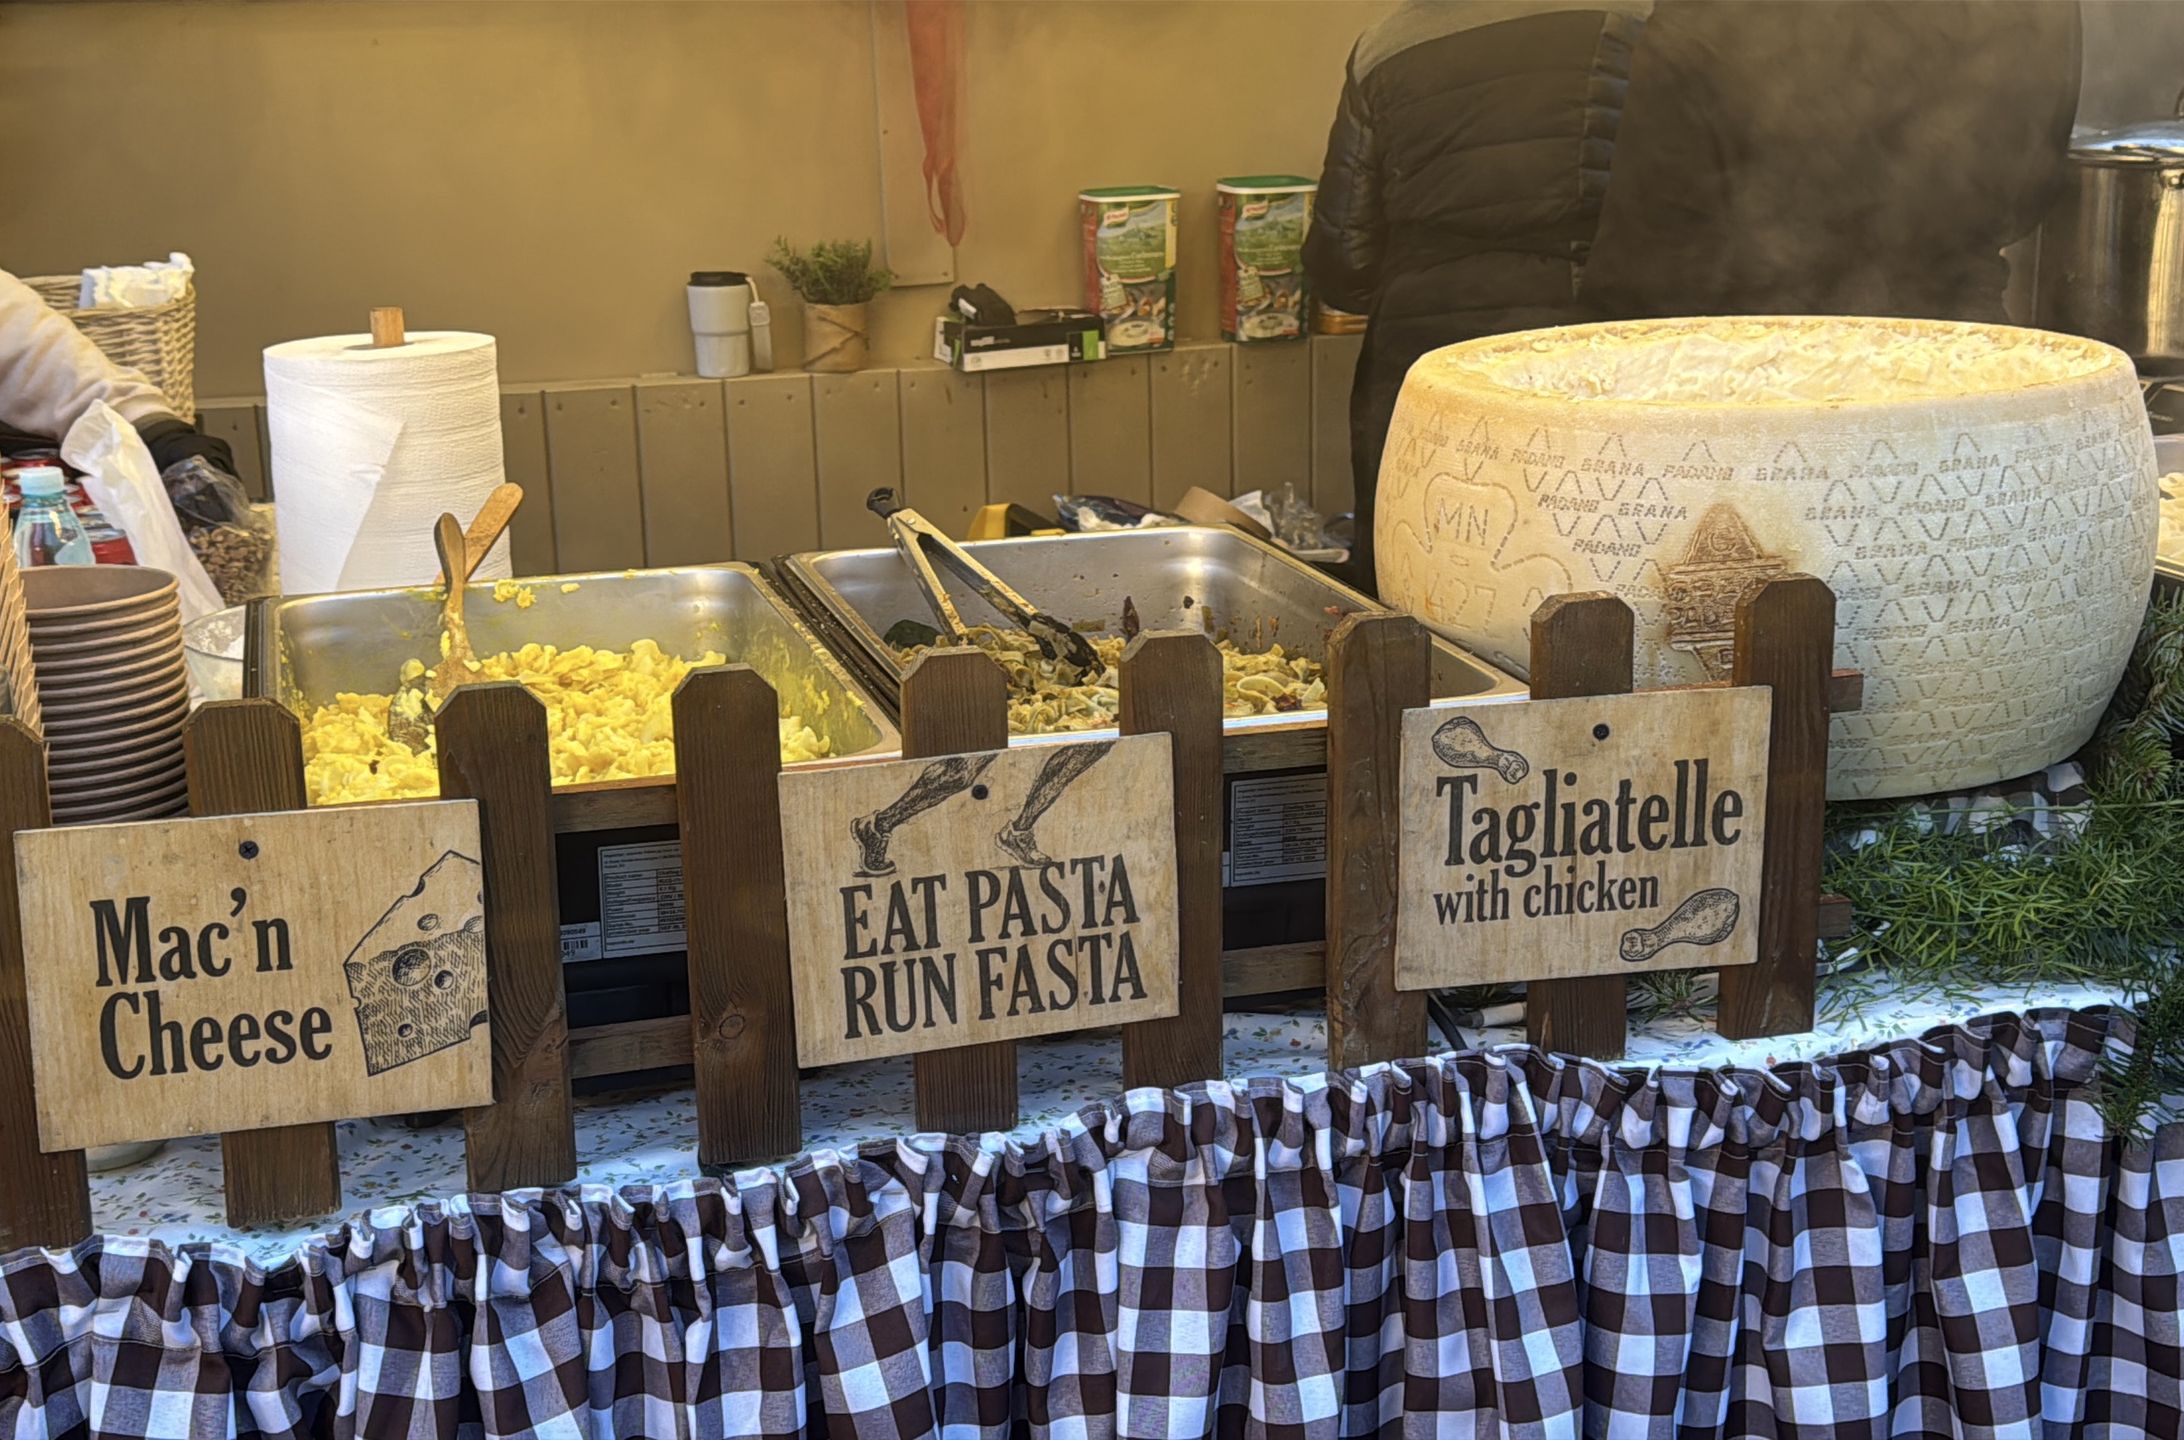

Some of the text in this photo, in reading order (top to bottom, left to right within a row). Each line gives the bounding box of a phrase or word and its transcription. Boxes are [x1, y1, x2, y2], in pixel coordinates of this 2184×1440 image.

[1581, 457, 1645, 477] GRANA
[1662, 463, 1735, 481] PADANO
[1755, 466, 1830, 482] GRANA
[1938, 454, 2000, 474] GRANA
[1433, 497, 1489, 547] MN
[1537, 494, 1600, 515] PADANO
[1617, 502, 1688, 521] GRANA
[1804, 504, 1880, 521] GRANA
[1984, 486, 2043, 508] GRANA
[1572, 538, 1643, 558] PADANO
[1854, 541, 1929, 560] GRANA
[1903, 579, 1972, 598] GRANA
[1436, 758, 1744, 878] Tagliatelle
[839, 853, 1141, 961] EAT PASTA
[1433, 860, 1660, 926] with chicken
[89, 887, 293, 987] Mac'n
[840, 930, 1148, 1039] RUN FASTA
[98, 990, 334, 1081] Cheese
